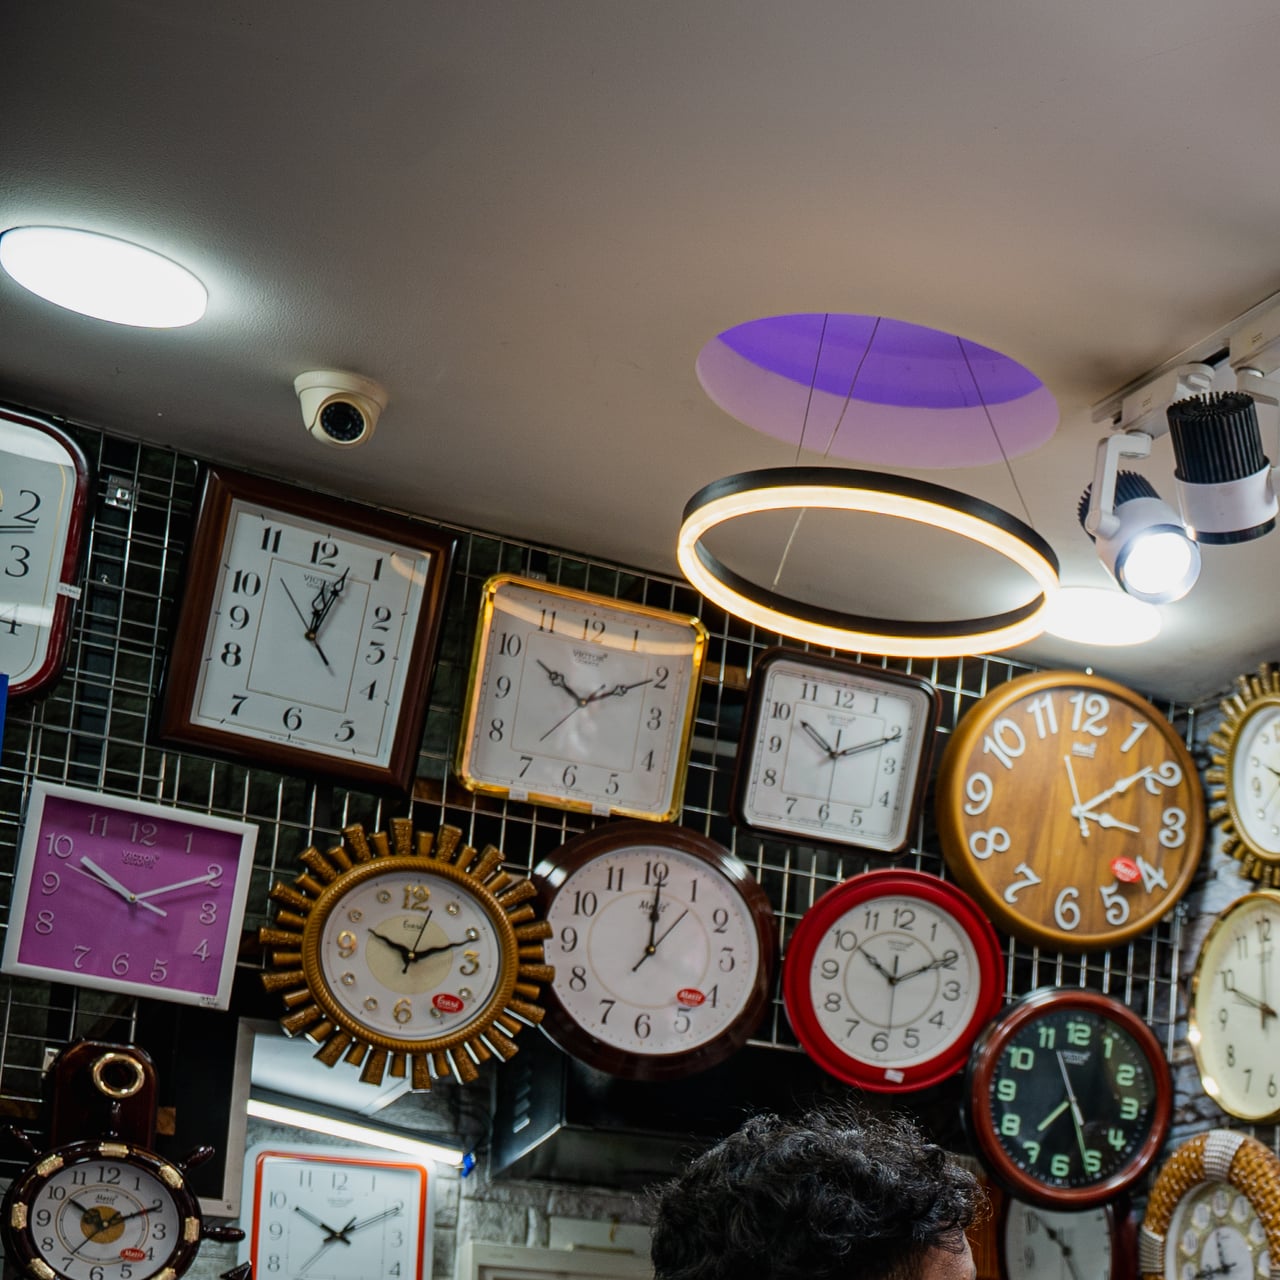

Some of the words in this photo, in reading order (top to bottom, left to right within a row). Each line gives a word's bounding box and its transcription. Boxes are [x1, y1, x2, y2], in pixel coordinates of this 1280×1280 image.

[261, 526, 282, 554] 11
[311, 539, 339, 568] 12
[371, 558, 383, 581] 1
[231, 569, 261, 597] 10
[229, 605, 250, 630] 9
[370, 606, 391, 631] 2
[537, 609, 556, 633] 11
[582, 619, 606, 643] 12
[631, 630, 639, 651] 1
[221, 642, 242, 667] 8
[365, 641, 386, 665] 3
[499, 633, 522, 657] 10
[359, 679, 378, 700] 4
[495, 676, 511, 699] 9
[654, 667, 669, 690] 2
[229, 694, 249, 717] 7
[1027, 694, 1058, 739] 11
[1069, 691, 1110, 736] 12
[282, 707, 303, 731] 6
[335, 719, 355, 742] 5
[489, 719, 504, 742] 8
[647, 708, 662, 731] 3
[983, 718, 1027, 769] 10
[1121, 721, 1148, 752] 1
[518, 755, 533, 778] 7
[641, 750, 655, 772] 4
[562, 765, 578, 787] 6
[605, 773, 619, 795] 5
[1142, 760, 1183, 795] 2
[964, 771, 993, 816] 9
[88, 812, 109, 837] 11
[130, 821, 158, 846] 12
[1158, 807, 1186, 848] 3
[45, 832, 73, 858] 10
[184, 832, 194, 854] 1
[968, 826, 1011, 859] 8
[41, 871, 61, 895] 9
[606, 866, 624, 892] 11
[1004, 863, 1041, 904] 7
[1136, 855, 1168, 893] 4
[401, 885, 430, 911] 12
[689, 879, 698, 902] 1
[199, 900, 217, 924] 3
[572, 890, 597, 917] 10
[1054, 886, 1080, 931] 6
[1100, 881, 1129, 926] 5
[35, 910, 54, 934] 8
[712, 909, 729, 933] 2
[864, 910, 879, 931] 11
[892, 908, 916, 931] 12
[560, 927, 577, 952] 9
[834, 929, 857, 951] 10
[931, 922, 937, 942] 1
[193, 939, 211, 962] 4
[337, 930, 357, 959] 9
[73, 945, 91, 969] 7
[111, 952, 129, 976] 6
[459, 950, 480, 976] 3
[719, 947, 735, 972] 3
[150, 958, 168, 982] 5
[569, 967, 587, 991] 8
[821, 959, 839, 980] 9
[824, 993, 841, 1012] 8
[942, 981, 960, 1001] 3
[393, 999, 412, 1024] 6
[600, 999, 616, 1025] 7
[674, 1008, 691, 1033] 5
[928, 1010, 944, 1029] 4
[634, 1014, 651, 1039] 6
[846, 1019, 860, 1038] 7
[903, 1028, 920, 1048] 5
[1038, 1027, 1055, 1049] 11
[1067, 1022, 1091, 1046] 12
[871, 1032, 889, 1052] 6
[1104, 1037, 1112, 1059] 1
[1009, 1047, 1034, 1070] 10
[1116, 1064, 1135, 1087] 2
[997, 1079, 1016, 1101] 9
[1120, 1098, 1139, 1120] 3
[1001, 1114, 1020, 1136] 8
[1108, 1128, 1126, 1151] 4
[1023, 1141, 1040, 1163] 7
[97, 1167, 121, 1184] 12
[1051, 1155, 1070, 1177] 6
[71, 1171, 87, 1185] 11
[134, 1176, 141, 1191] 1
[48, 1186, 66, 1200] 10
[36, 1209, 50, 1226] 9
[41, 1237, 54, 1251] 8
[152, 1225, 166, 1240] 3
[61, 1257, 74, 1272] 7
[120, 1264, 132, 1279] 5
